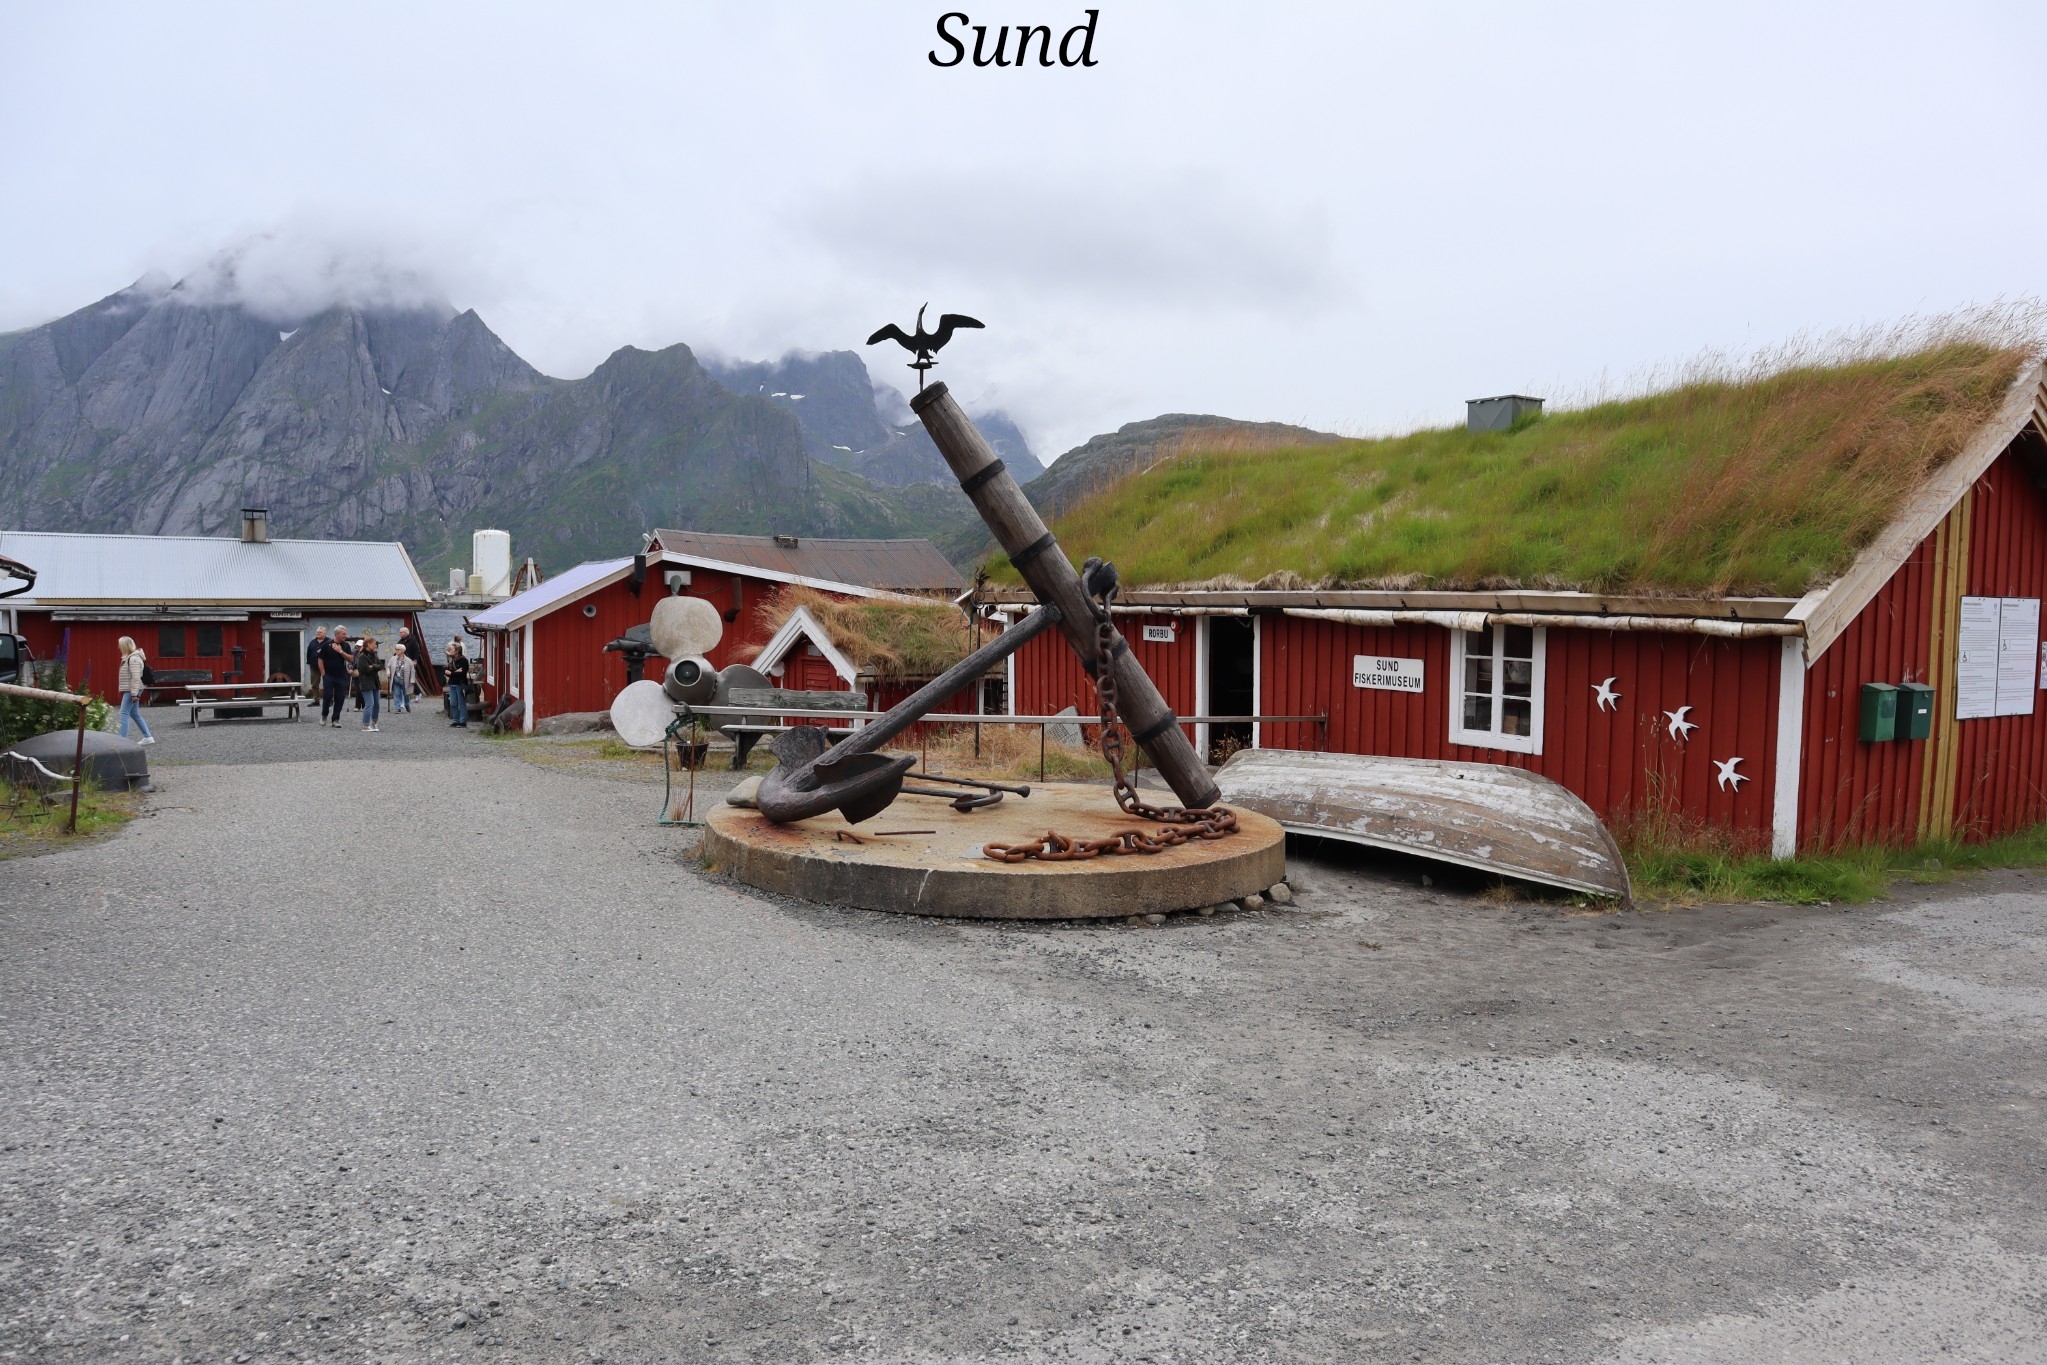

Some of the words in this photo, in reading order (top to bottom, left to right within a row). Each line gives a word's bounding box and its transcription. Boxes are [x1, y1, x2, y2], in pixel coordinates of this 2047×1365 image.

[1149, 629, 1169, 639] RORBU
[1376, 659, 1399, 672] SUND
[1354, 673, 1421, 689] FISKERIMUSEUM
